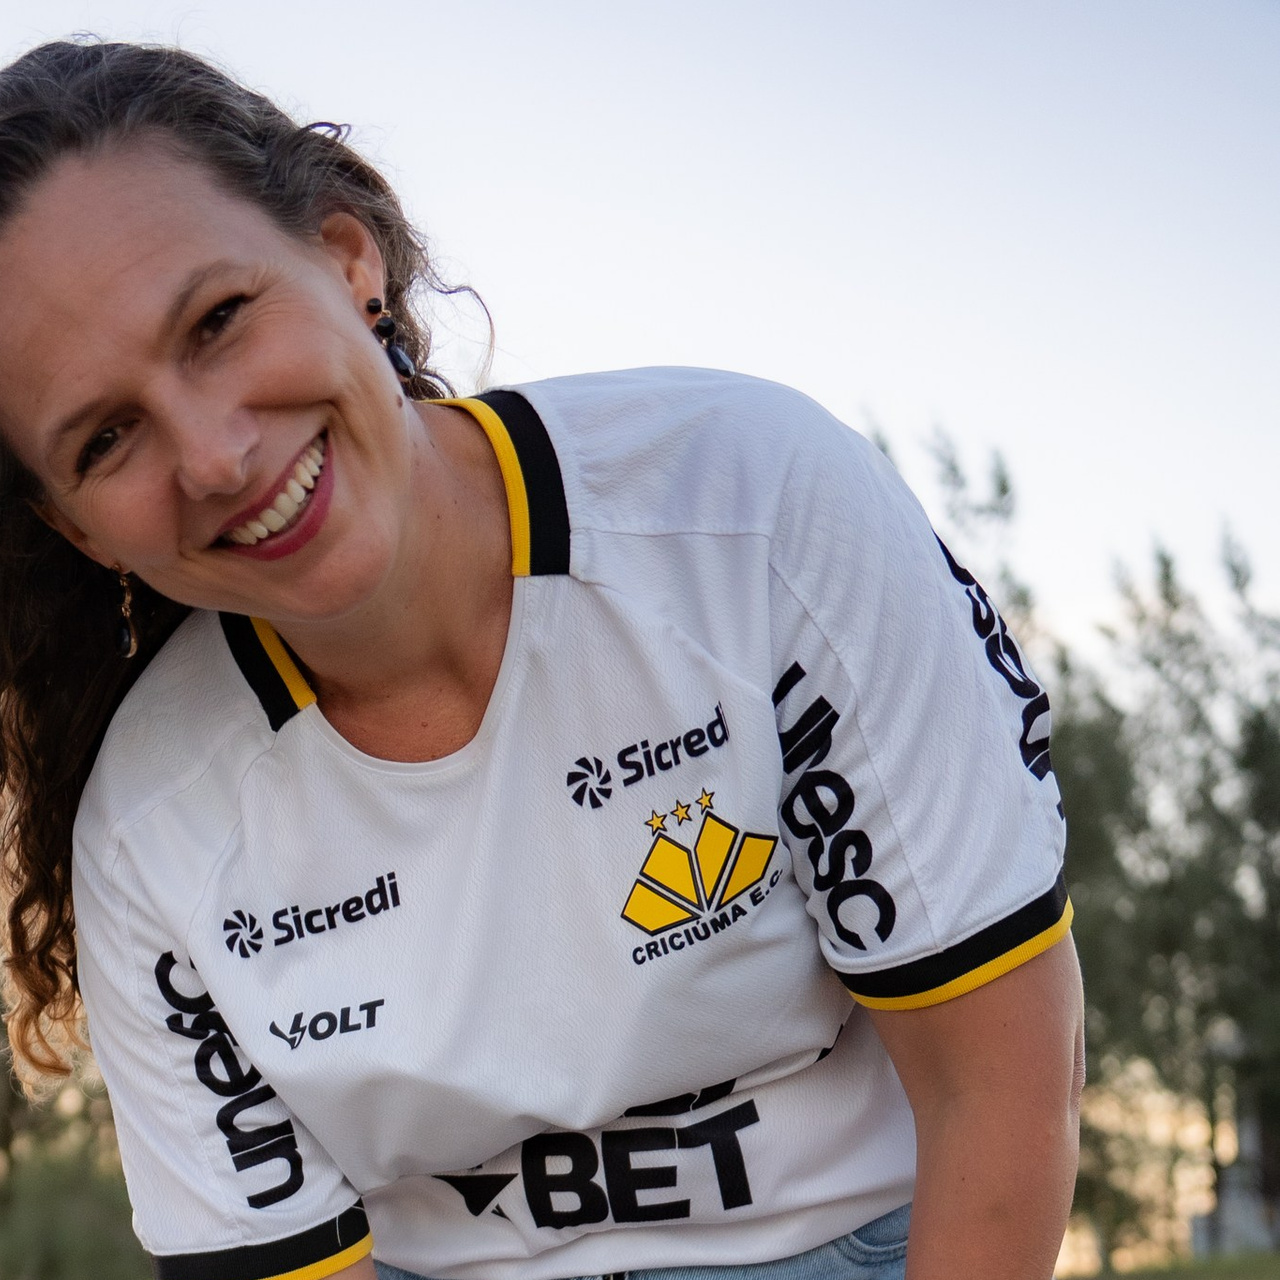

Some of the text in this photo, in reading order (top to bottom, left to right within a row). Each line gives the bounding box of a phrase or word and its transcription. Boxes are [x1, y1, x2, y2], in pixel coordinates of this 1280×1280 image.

[617, 701, 730, 787] Sicred
[272, 871, 400, 946] Sicredi
[632, 907, 747, 965] CRICIÚMA
[269, 999, 385, 1050] VOLT
[155, 950, 304, 1209] unesc
[521, 1099, 760, 1229] BET
